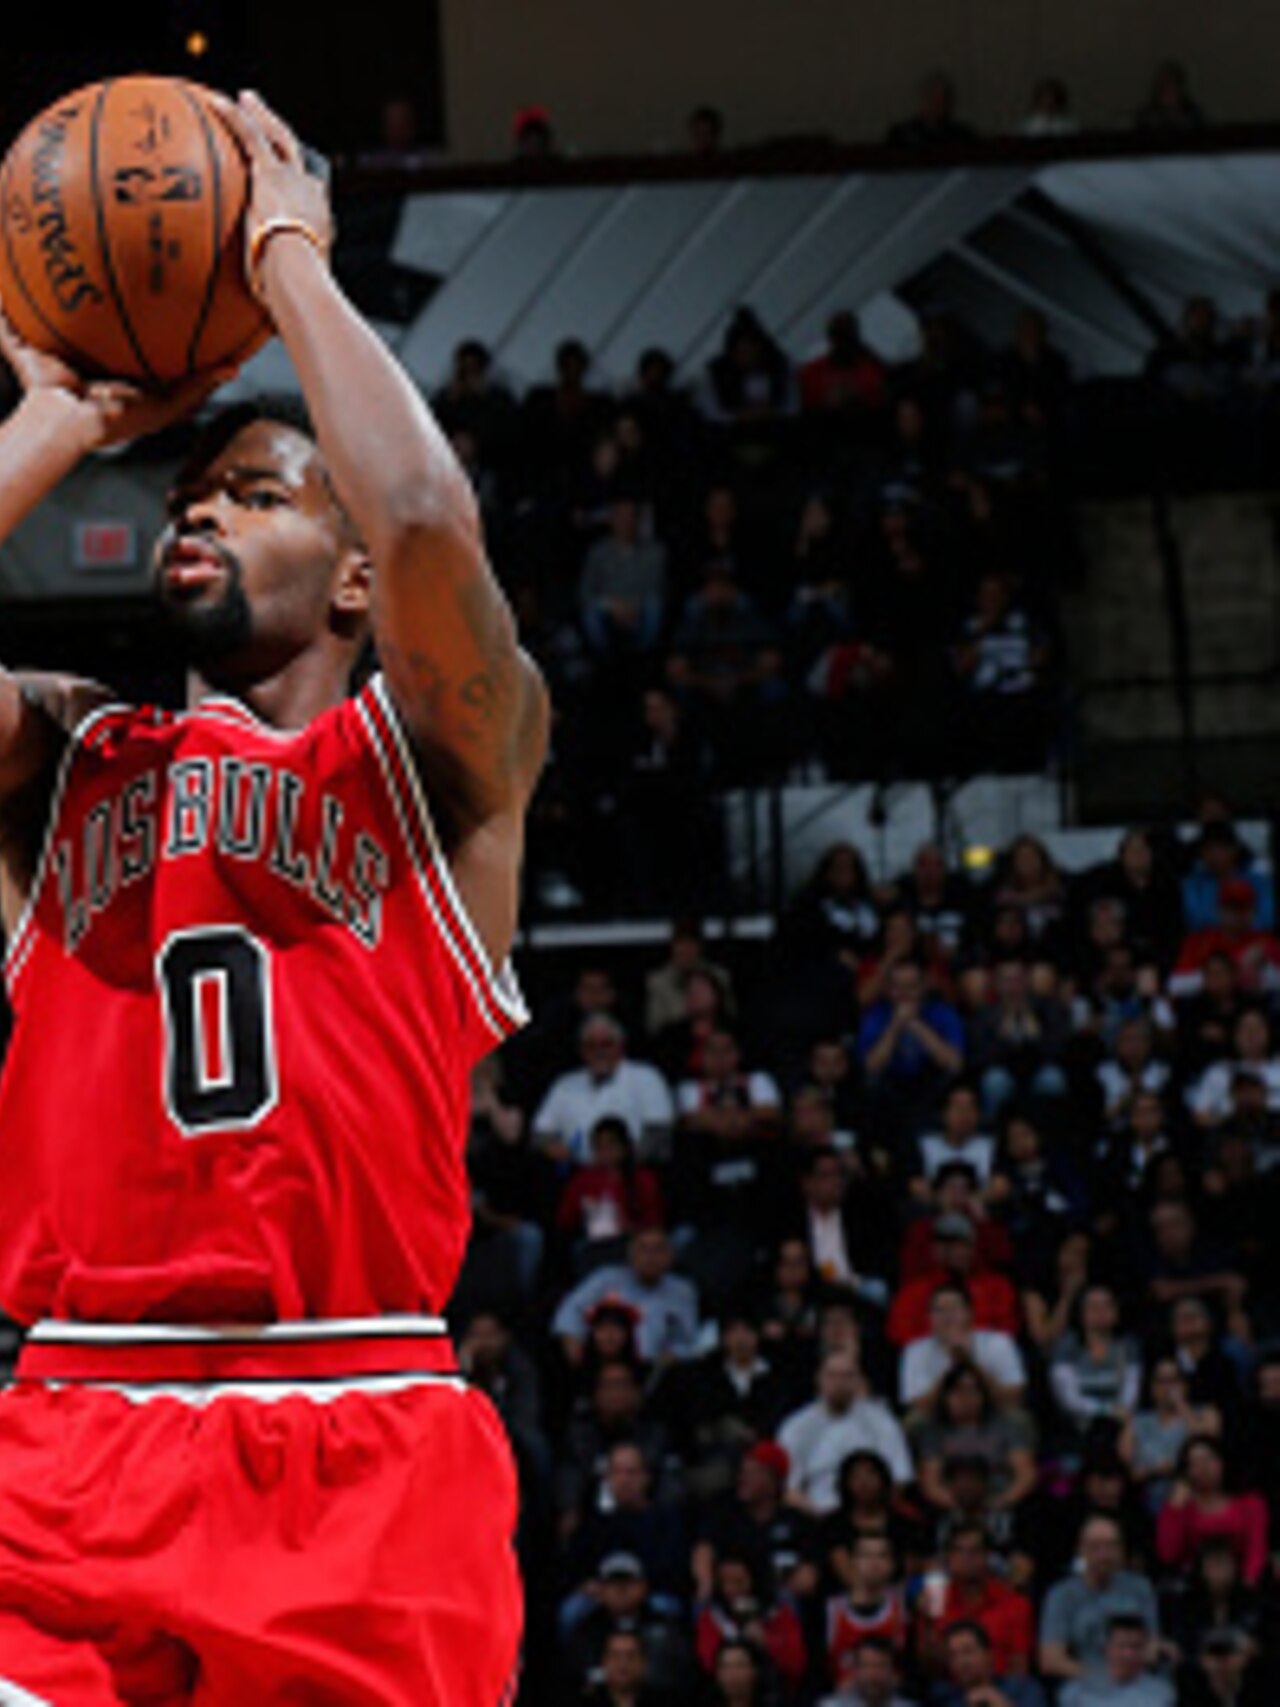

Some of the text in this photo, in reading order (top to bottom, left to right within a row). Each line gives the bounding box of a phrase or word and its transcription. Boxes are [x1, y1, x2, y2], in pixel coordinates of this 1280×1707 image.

[52, 755, 388, 957] LOS BULLS
[154, 924, 279, 1138] 0
